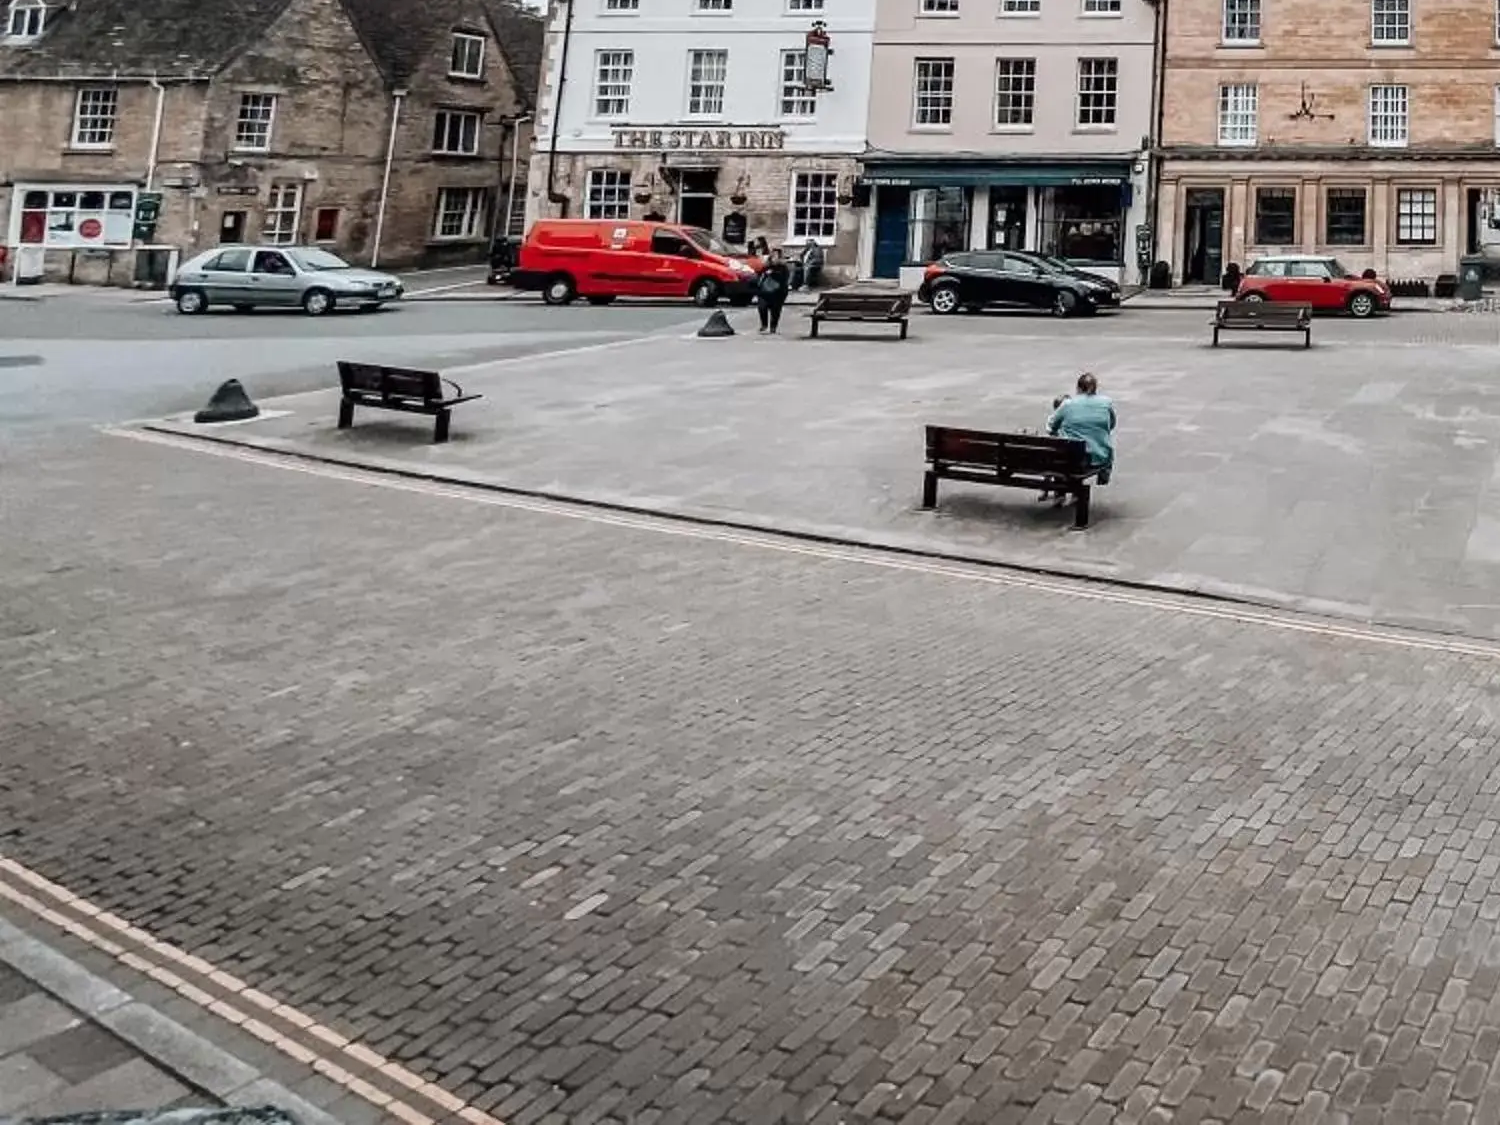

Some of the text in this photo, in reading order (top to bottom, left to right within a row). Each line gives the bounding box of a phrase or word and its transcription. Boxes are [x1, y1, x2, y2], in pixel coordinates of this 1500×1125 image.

[612, 130, 787, 150] THE STAR INN
